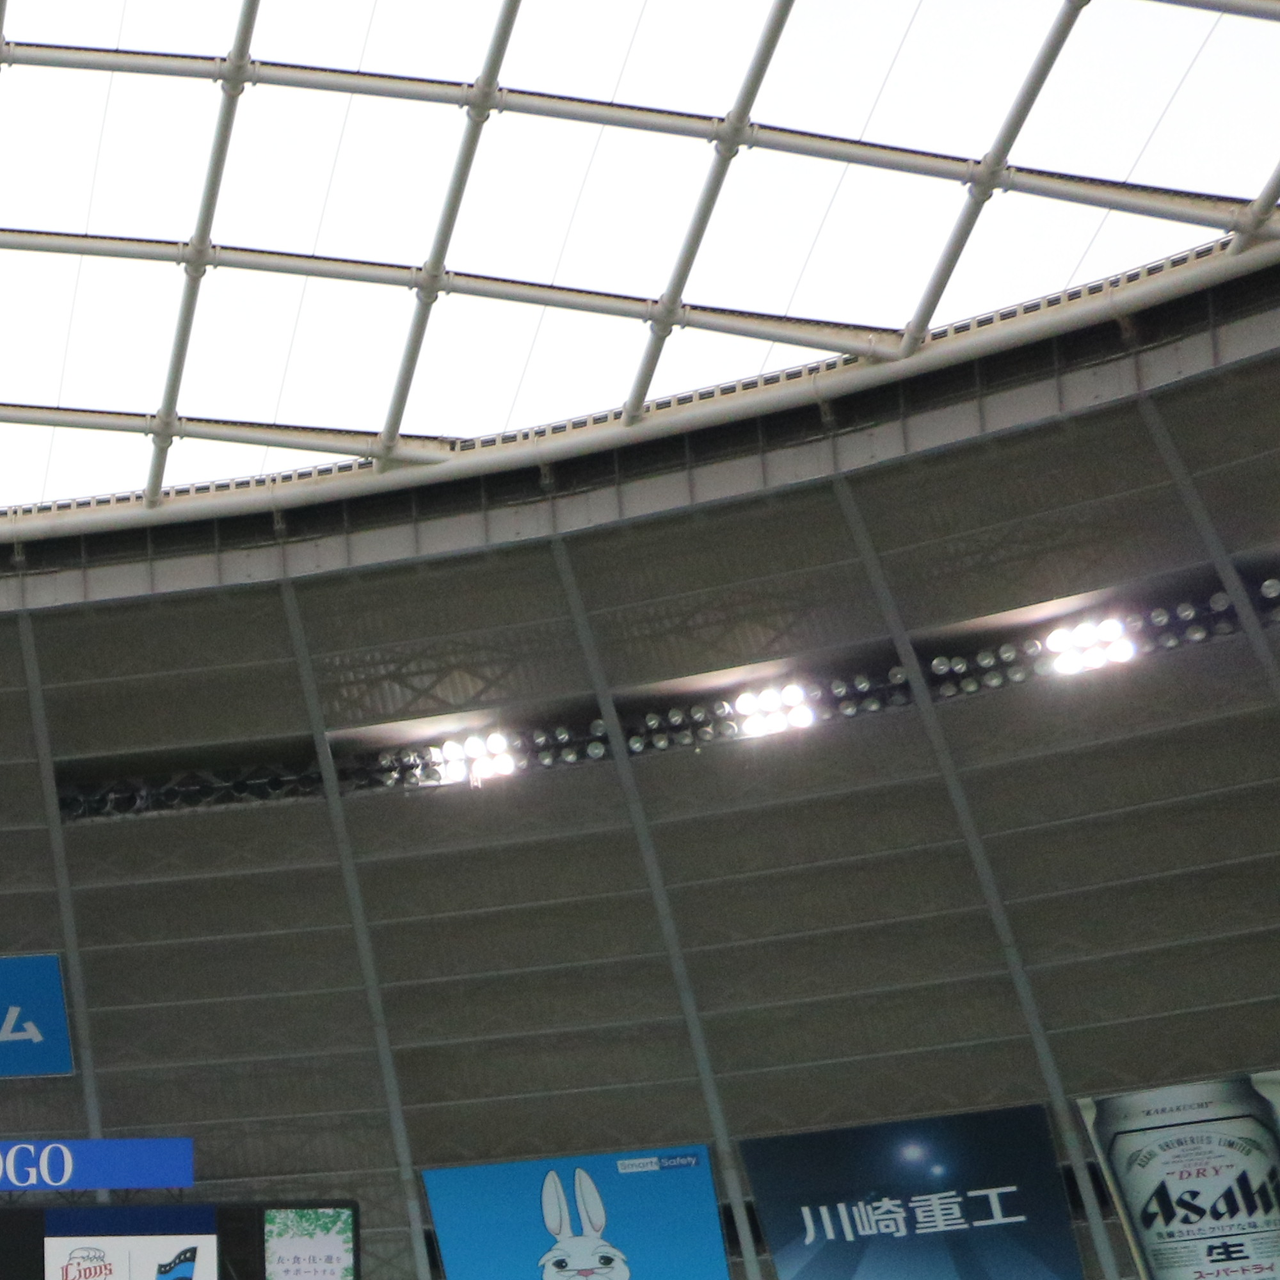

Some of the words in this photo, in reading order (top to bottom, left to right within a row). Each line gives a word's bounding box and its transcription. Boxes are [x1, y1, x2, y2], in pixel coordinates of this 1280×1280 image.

[800, 1186, 1026, 1246] 川崎重工
[1206, 1242, 1250, 1263] 生
[1193, 1263, 1275, 1280] スーパードライ
